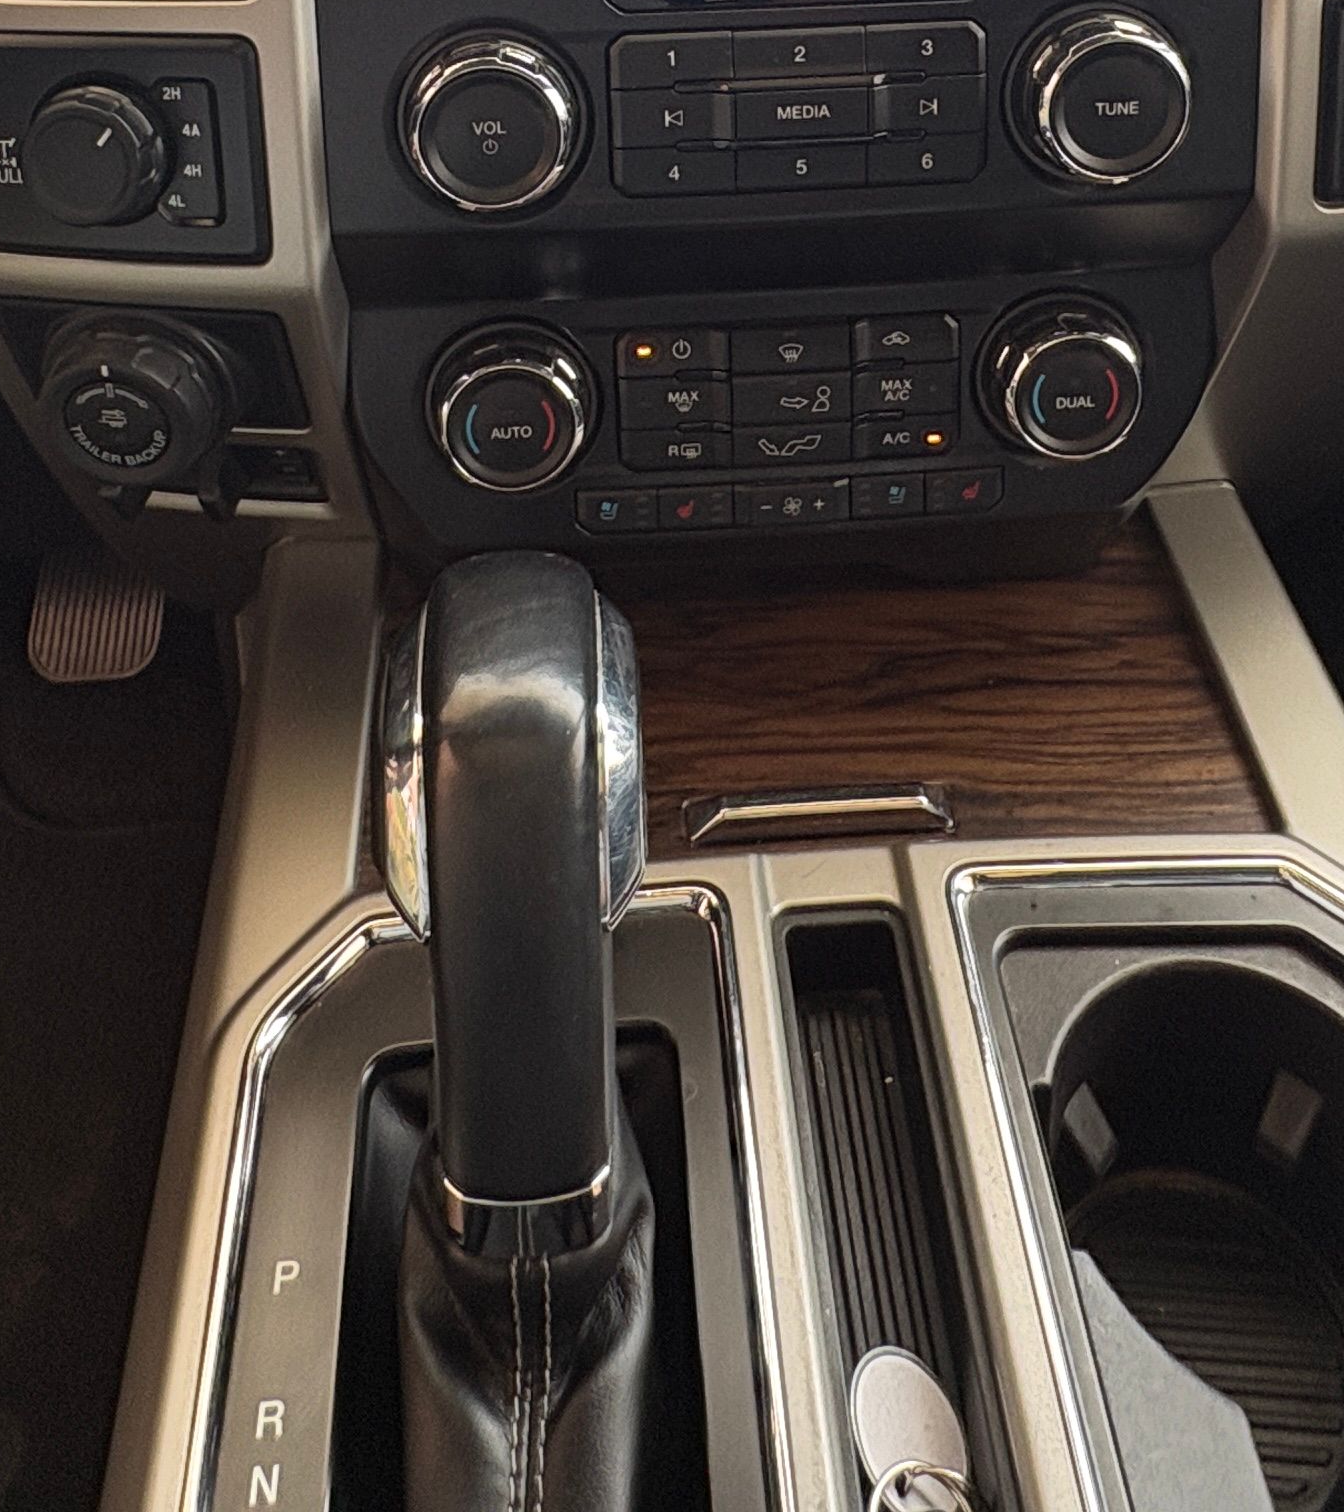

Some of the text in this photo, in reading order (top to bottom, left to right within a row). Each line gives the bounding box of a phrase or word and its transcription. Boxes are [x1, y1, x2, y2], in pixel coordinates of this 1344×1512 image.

[794, 46, 806, 63] 2
[921, 40, 933, 56] 3
[667, 51, 676, 67] 1
[162, 87, 181, 101] 2H
[777, 105, 831, 120] MEDIA
[1095, 100, 1139, 116] TUNE
[182, 124, 201, 137] 4A
[472, 121, 507, 136] VOL
[796, 159, 808, 175] 5
[922, 153, 934, 169] 6
[184, 164, 202, 177] 4H
[668, 165, 680, 181] 4
[168, 195, 186, 208] 4L
[881, 379, 912, 391] MAX
[668, 391, 699, 403] MAX
[884, 390, 911, 402] A/C
[1056, 395, 1096, 409] DUAL
[491, 425, 533, 439] AUTO
[882, 432, 911, 445] A/C
[70, 424, 167, 467] TRAILER BACKUP
[272, 1260, 301, 1296] P
[256, 1399, 285, 1441] R
[248, 1463, 280, 1508] N
